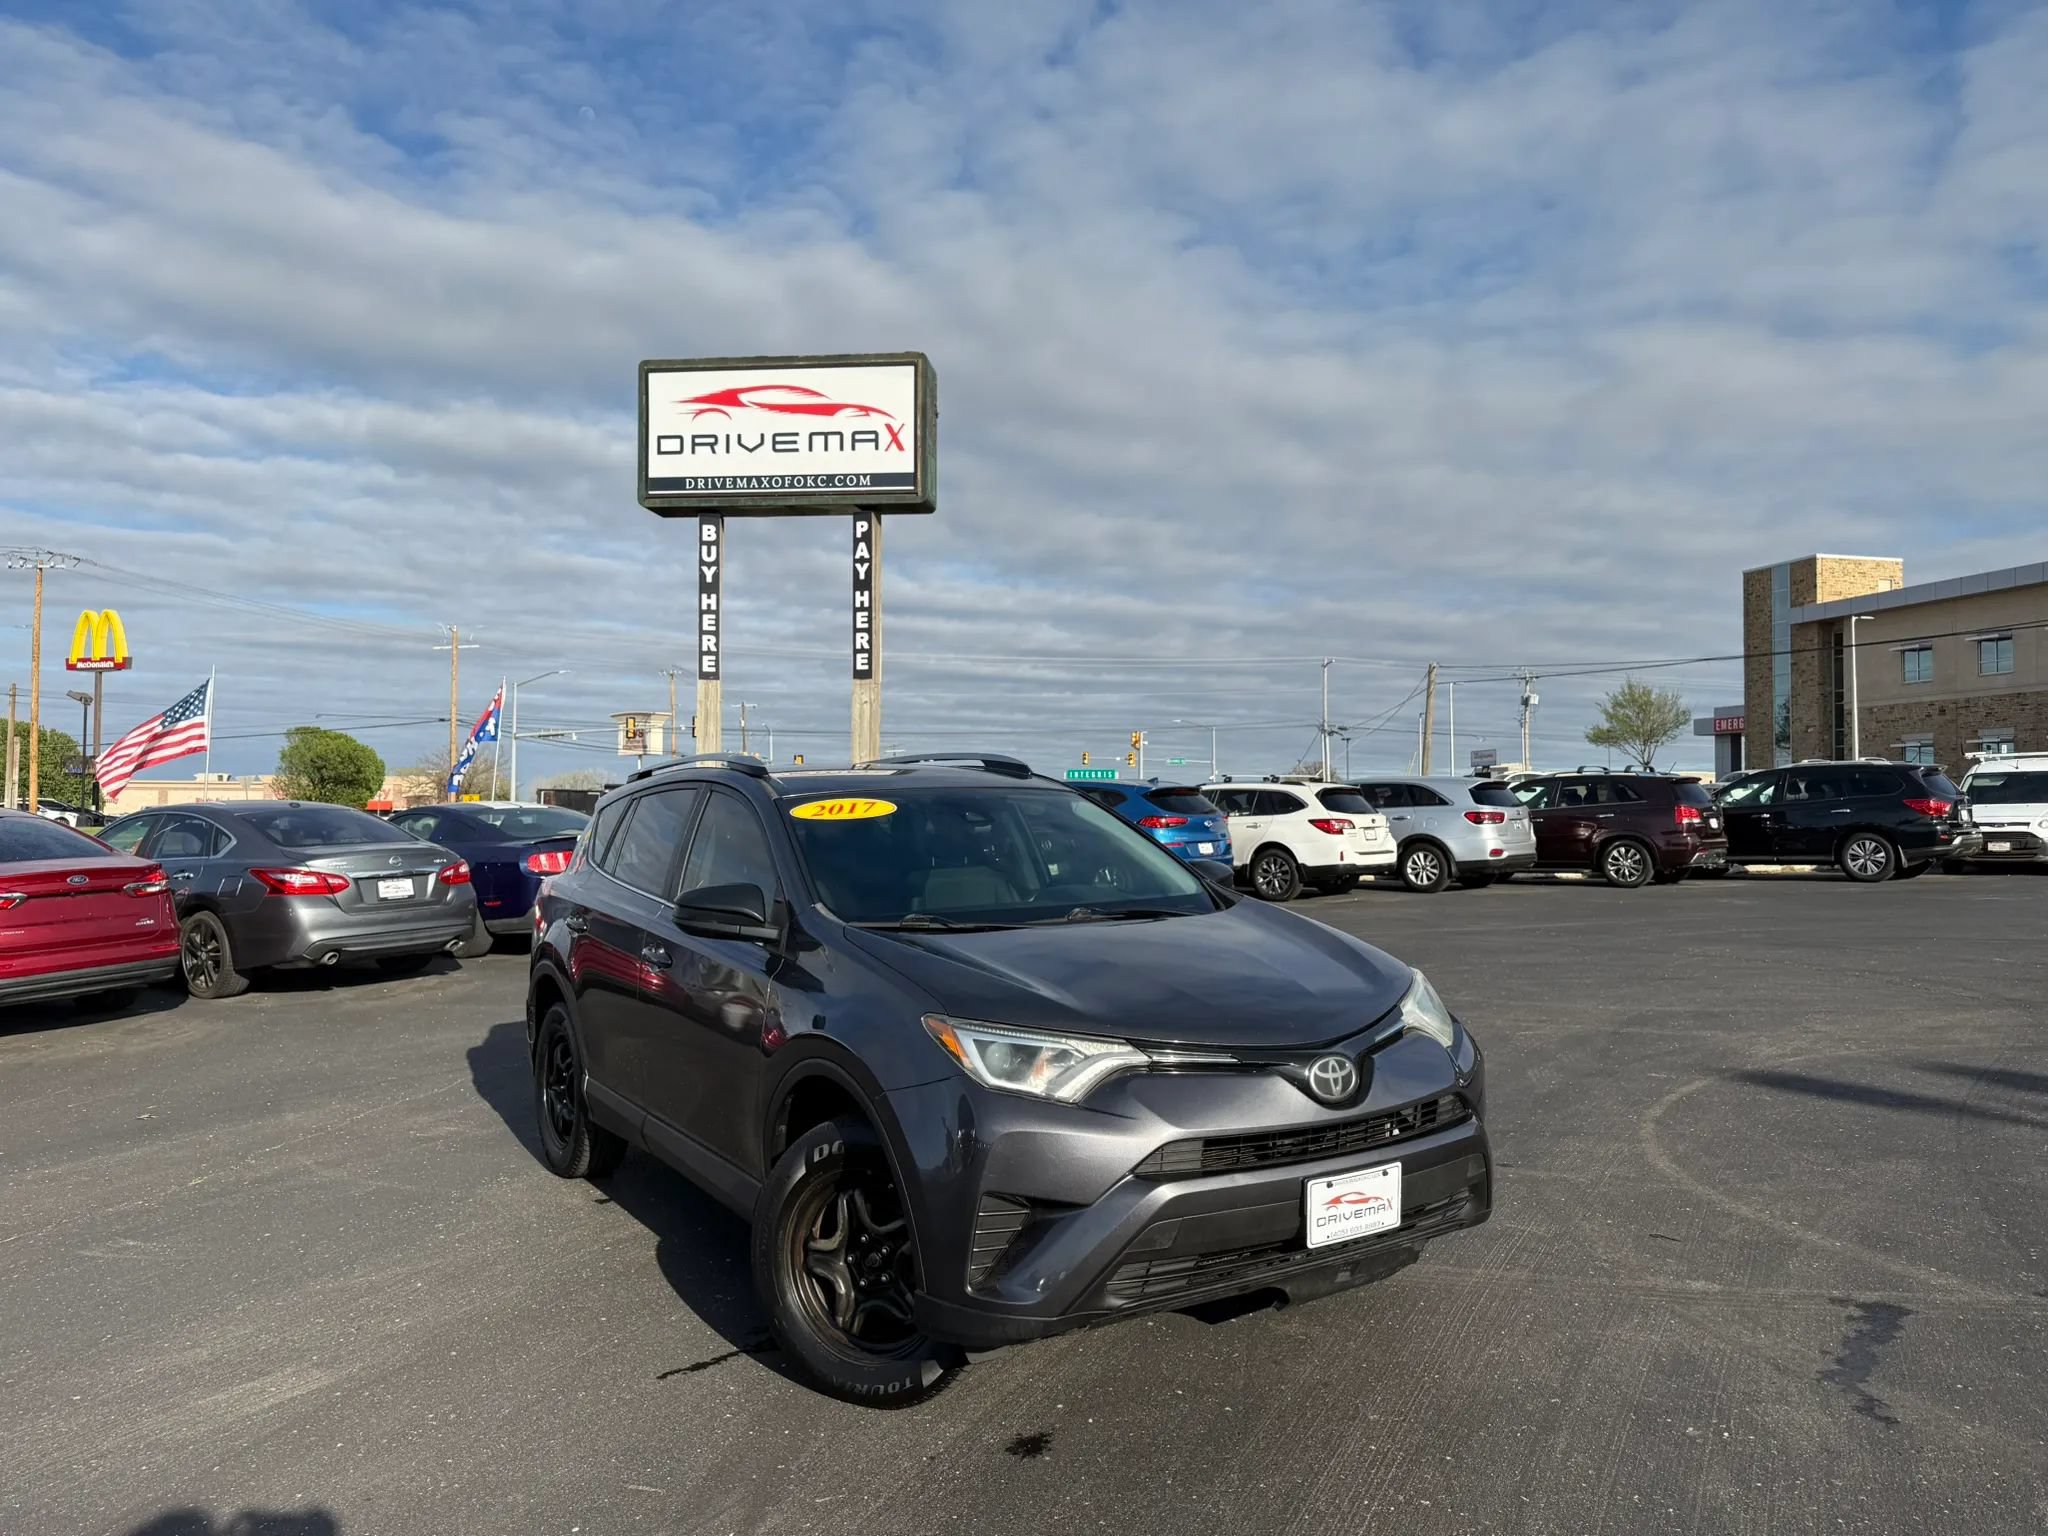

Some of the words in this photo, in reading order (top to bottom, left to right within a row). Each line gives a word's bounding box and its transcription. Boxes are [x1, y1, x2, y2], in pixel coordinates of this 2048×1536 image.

[657, 423, 905, 455] DRIVEMAX
[685, 474, 871, 490] DRIVEMAXOFOKC.COM
[701, 524, 717, 583] BUY
[855, 521, 870, 580] PAY
[701, 593, 717, 673] HERE
[855, 590, 870, 670] HERE
[1715, 717, 1744, 731] EMERG
[810, 801, 876, 817] 2017
[1316, 1198, 1393, 1227] DRIVEMAX
